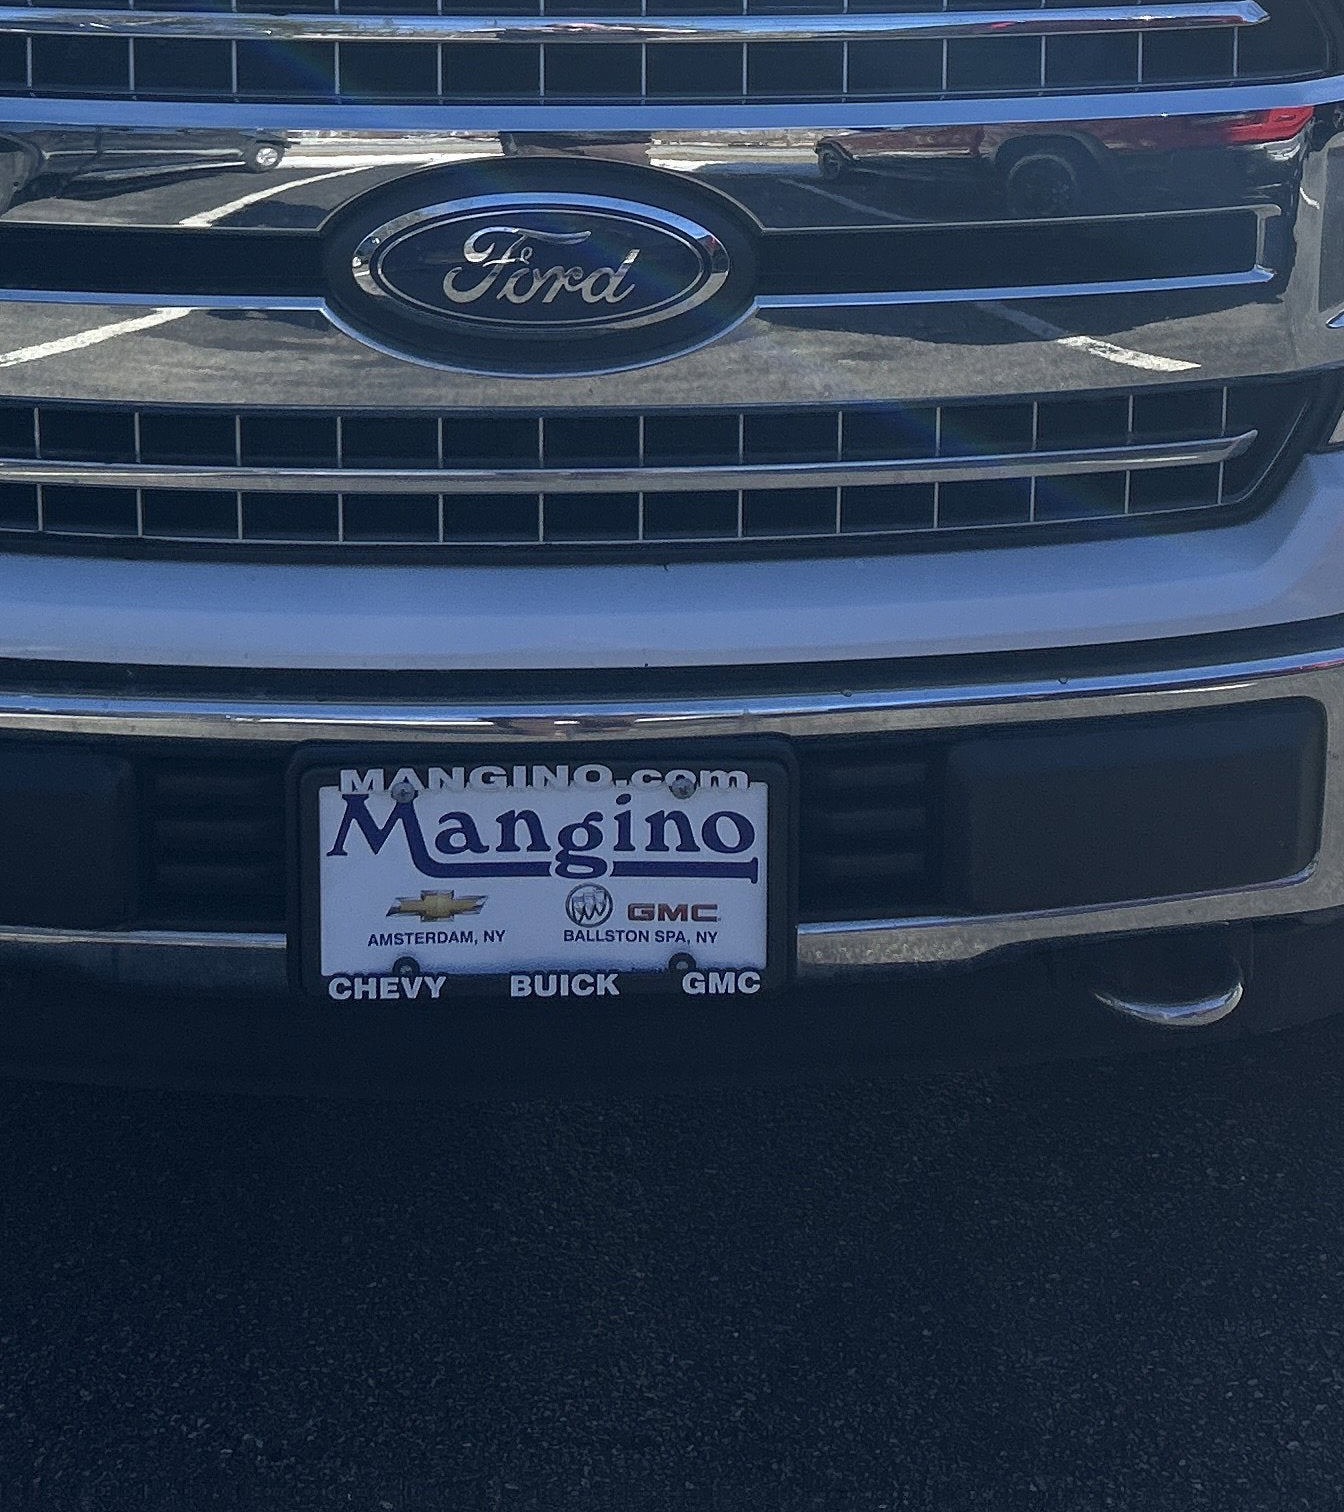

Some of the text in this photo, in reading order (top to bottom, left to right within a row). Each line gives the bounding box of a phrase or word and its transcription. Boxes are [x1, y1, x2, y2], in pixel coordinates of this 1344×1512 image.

[441, 225, 641, 305] Ford
[339, 763, 751, 794] MANGINO.com
[325, 793, 760, 884] Mangino
[627, 902, 719, 923] GMC
[367, 929, 507, 947] AMSTERDAM, NY
[563, 929, 719, 945] BALLSTON SPA, NY
[328, 971, 762, 1001] CHEVY BUICK GMC
